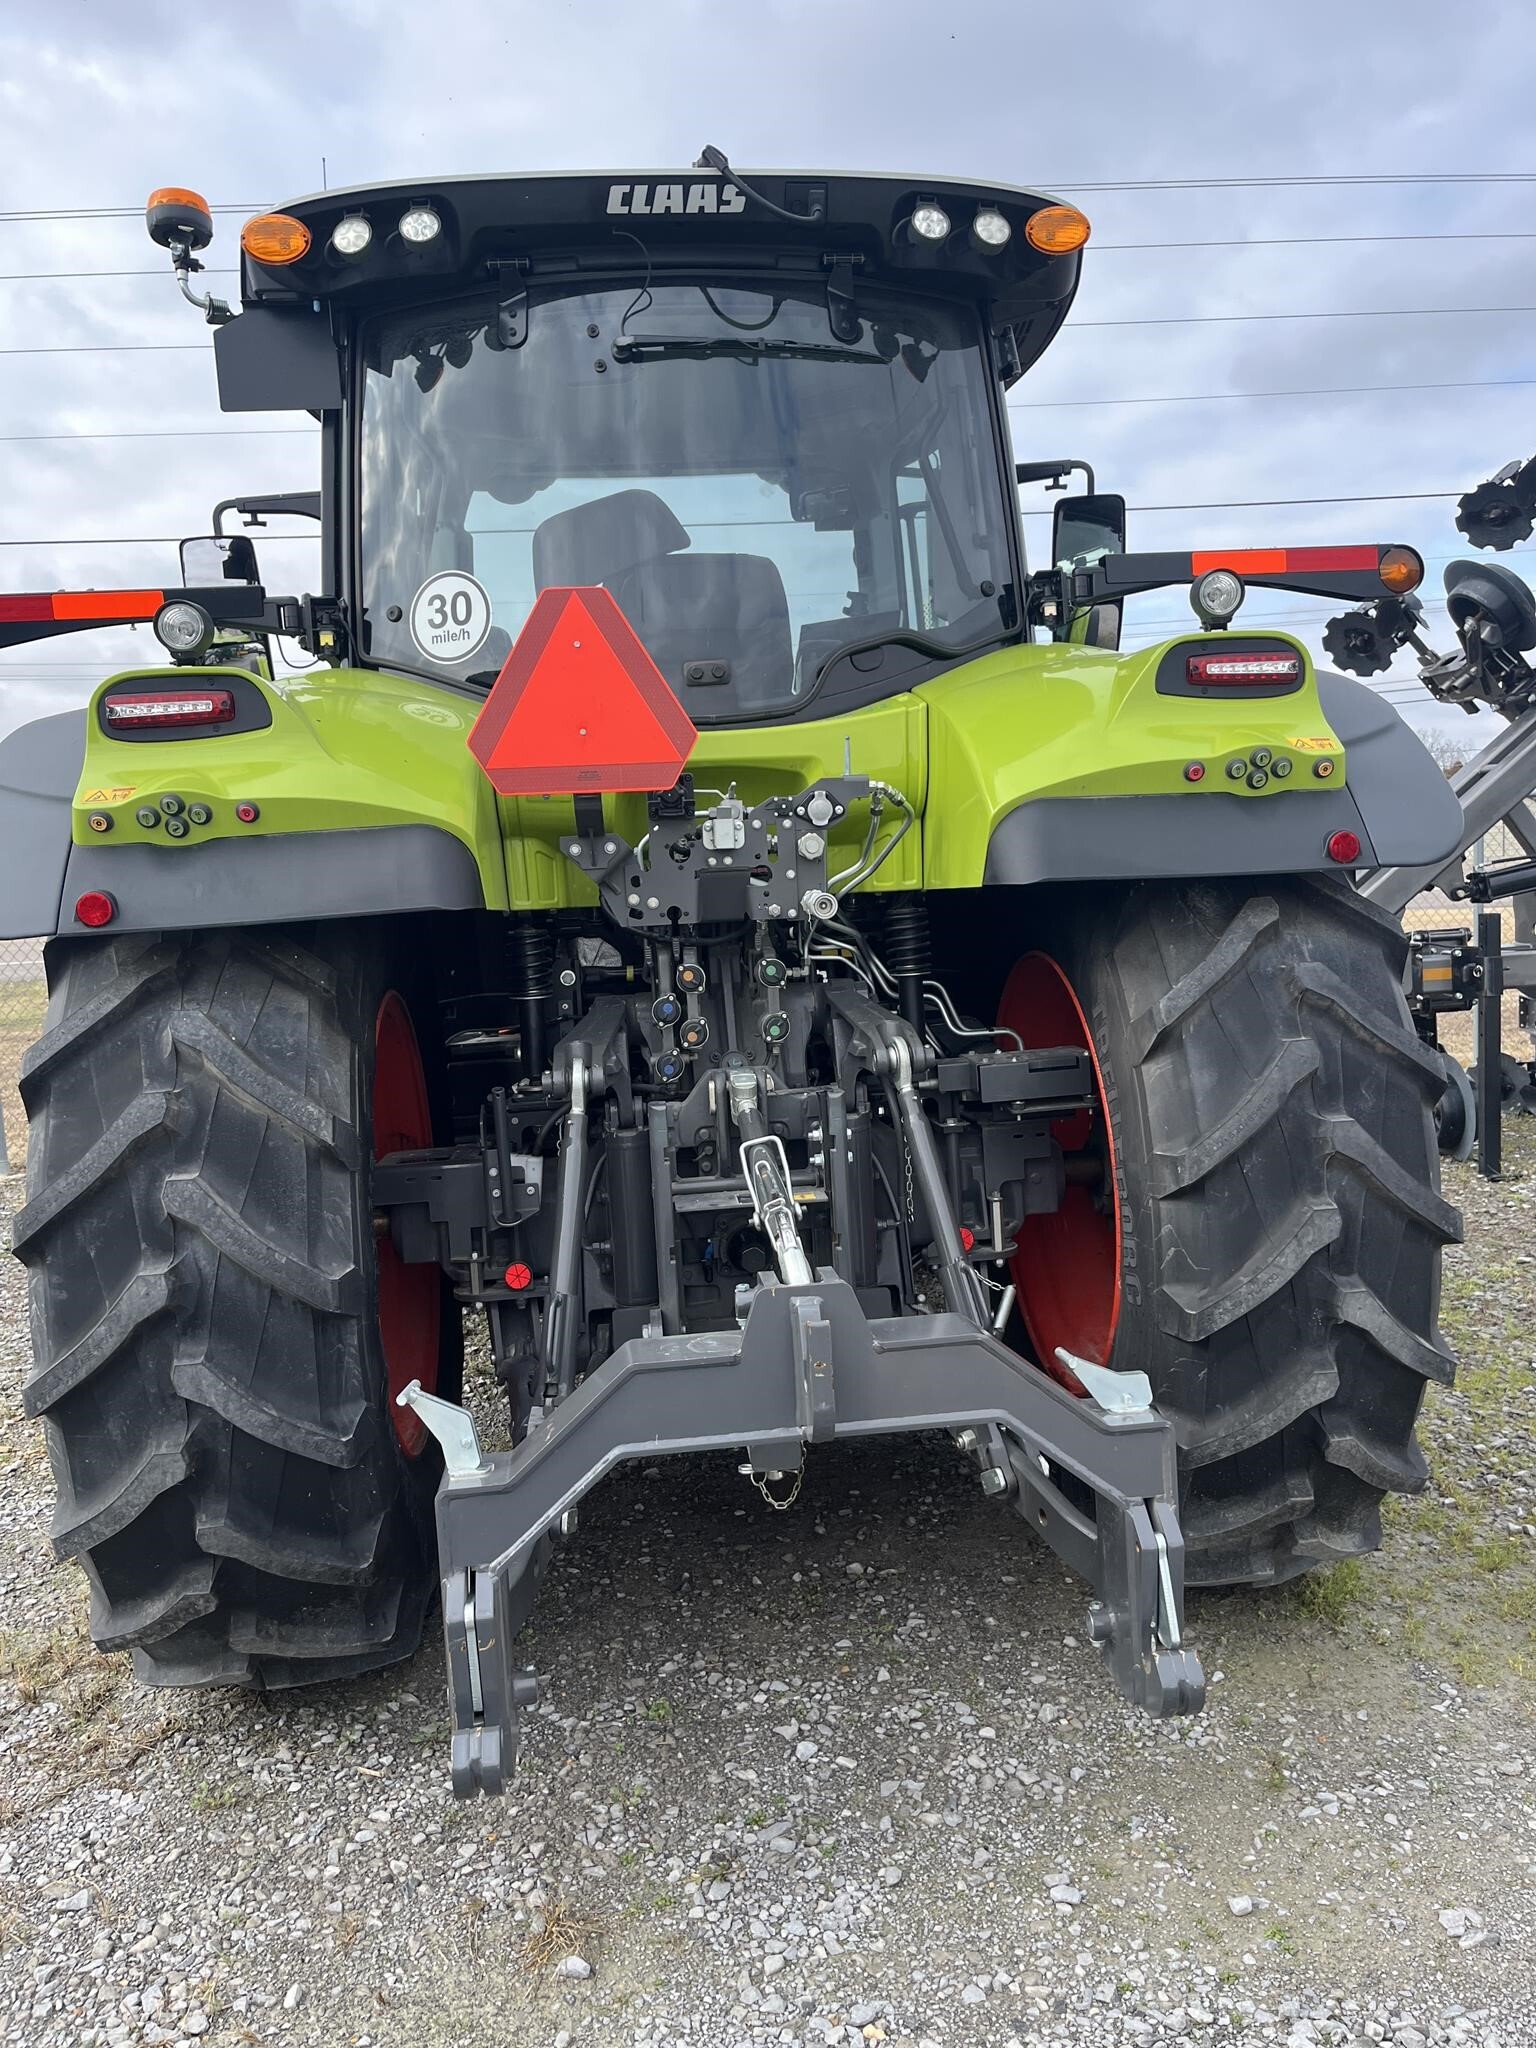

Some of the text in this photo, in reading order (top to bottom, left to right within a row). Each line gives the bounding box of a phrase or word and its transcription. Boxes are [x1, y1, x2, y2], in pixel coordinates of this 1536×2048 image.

[606, 184, 746, 214] CLAAS
[427, 590, 472, 629] 30
[431, 628, 471, 645] mile/h
